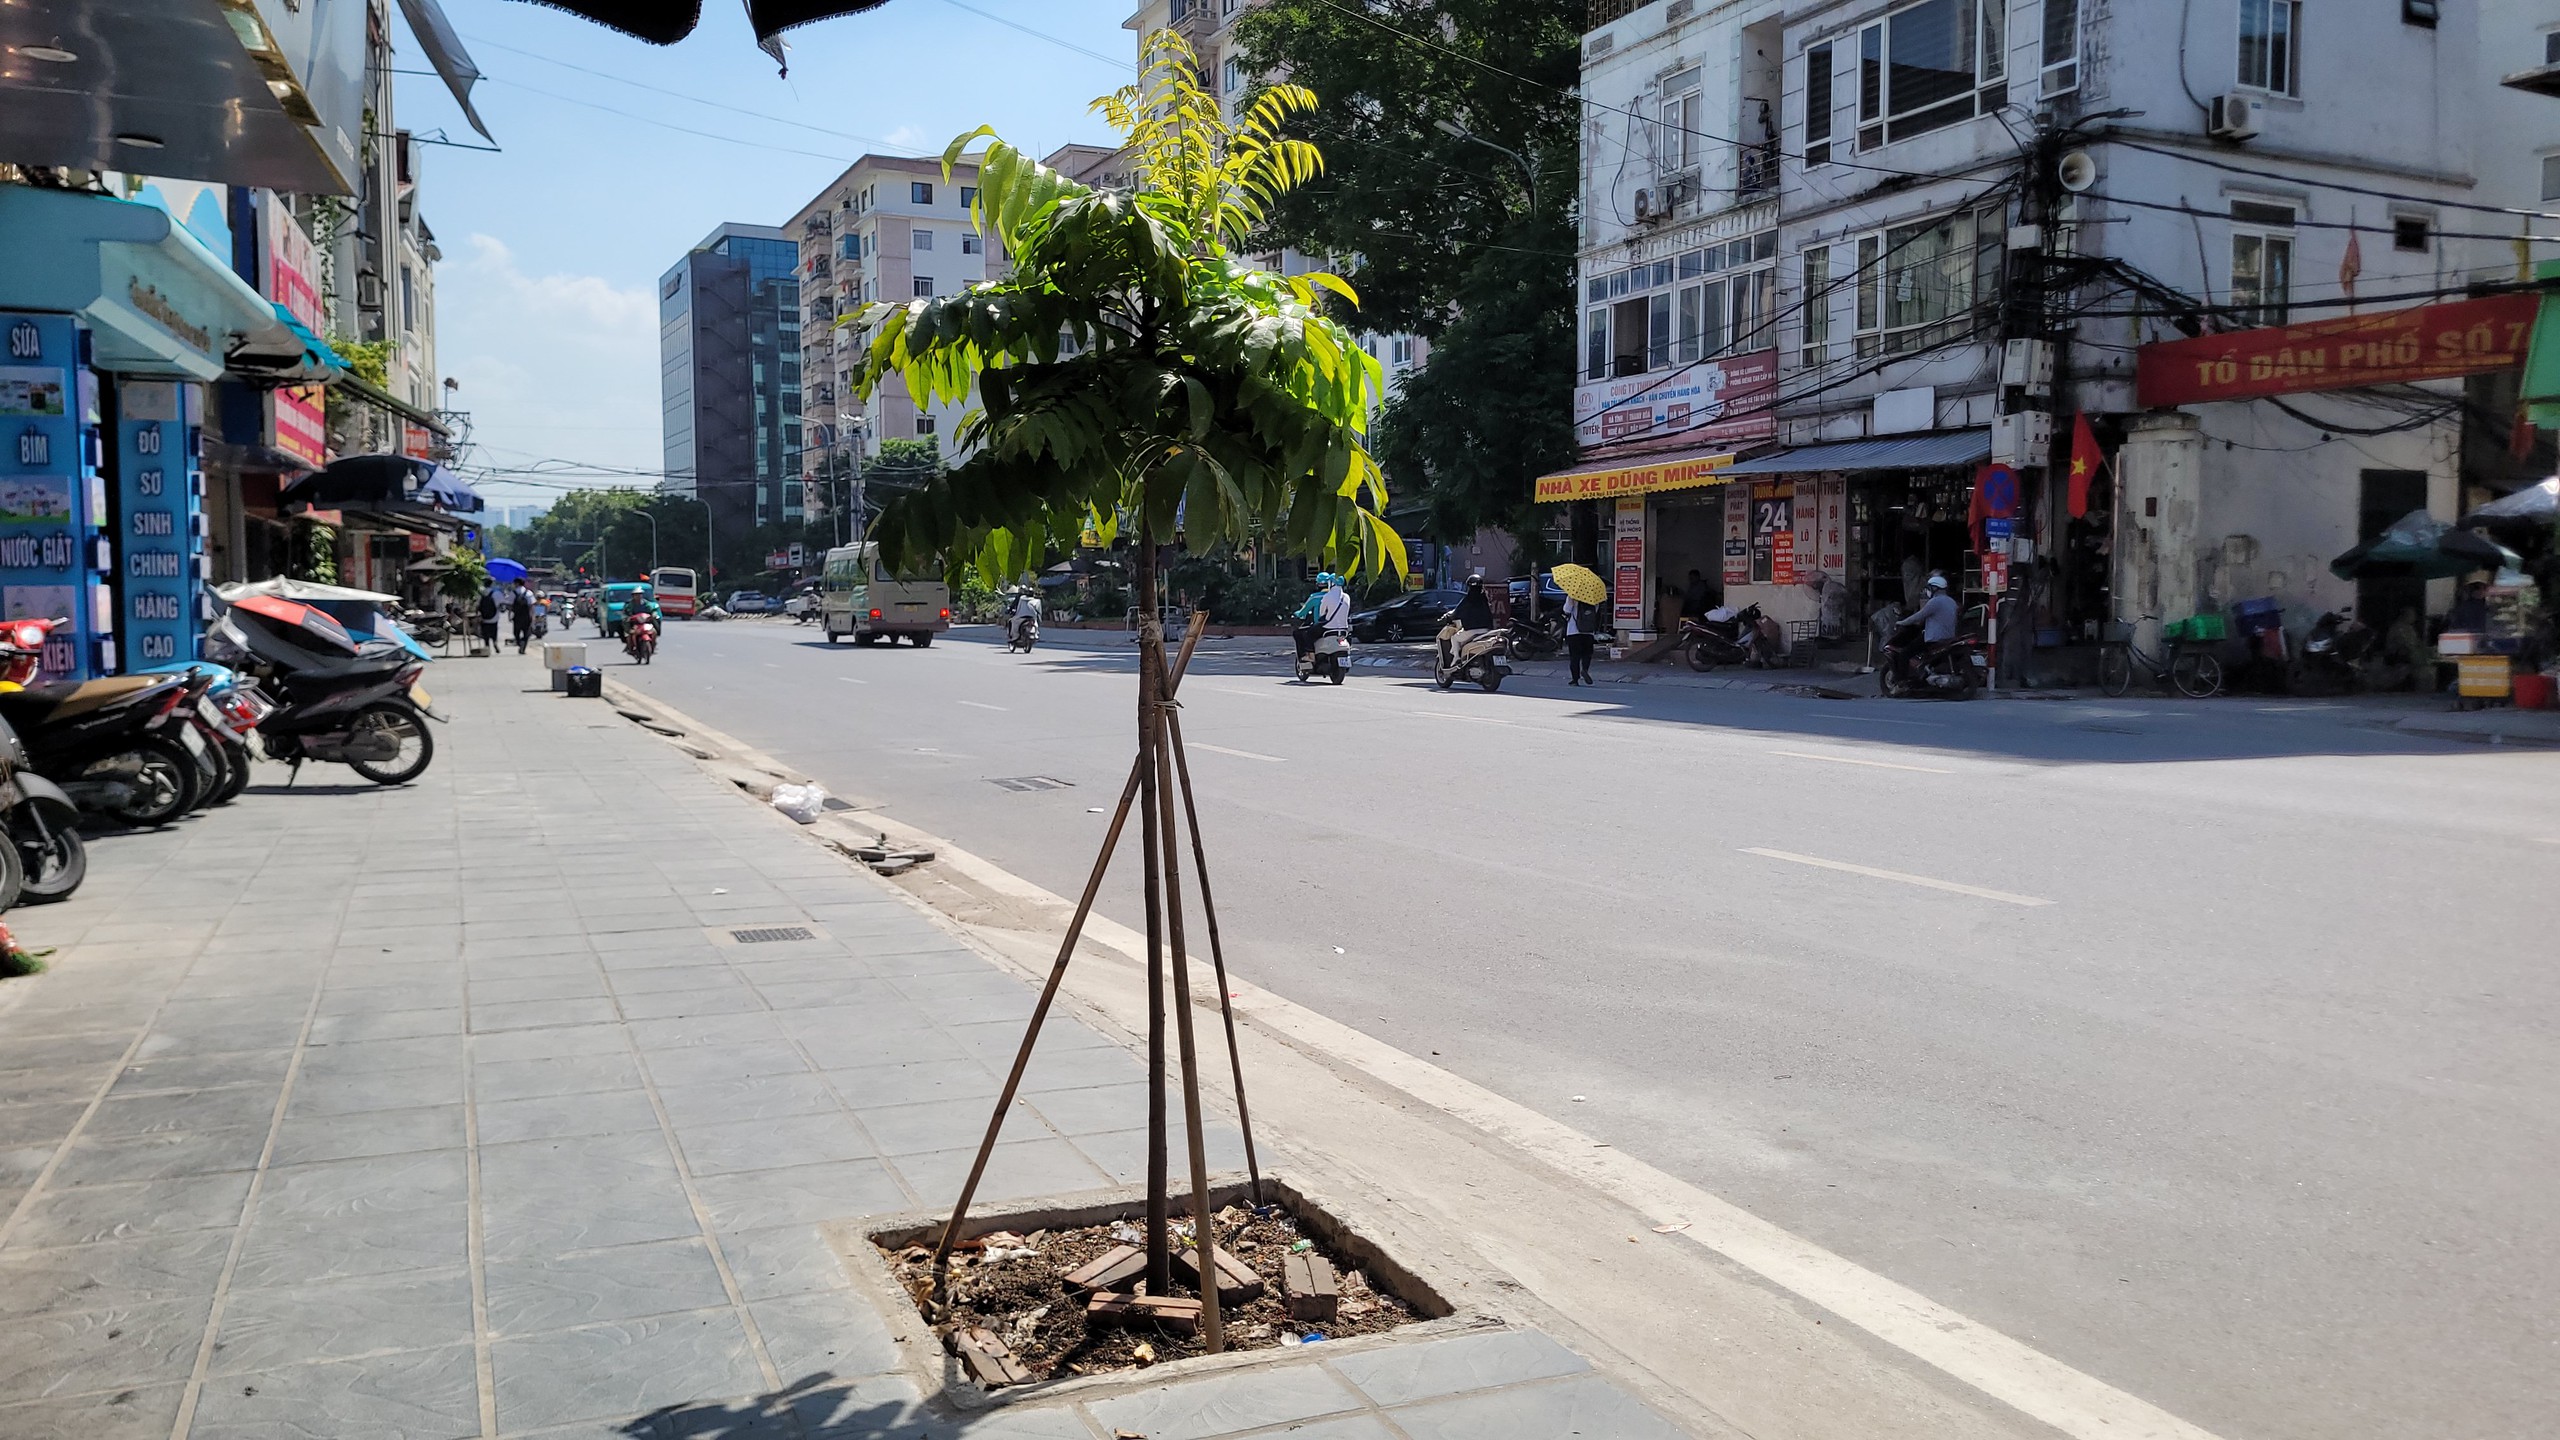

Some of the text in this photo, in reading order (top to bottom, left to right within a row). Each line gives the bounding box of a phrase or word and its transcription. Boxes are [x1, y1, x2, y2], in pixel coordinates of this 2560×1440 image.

[11, 322, 40, 357] SỮA
[2249, 348, 2325, 381] DÂN
[2339, 327, 2421, 368] PHỐ
[2434, 317, 2495, 359] SỐ
[1539, 463, 1714, 495] NHÀ XE DŨNG MINH
[133, 512, 171, 535] SINH
[1759, 502, 1788, 533] 24
[1829, 505, 1838, 522] BỊ
[0, 533, 39, 567] NƯỚC
[130, 549, 179, 576] CHÍNH
[1794, 554, 1803, 565] XE
[1823, 554, 1843, 568] SINH
[42, 637, 75, 676] KIỆN
[142, 635, 173, 658] CAO
